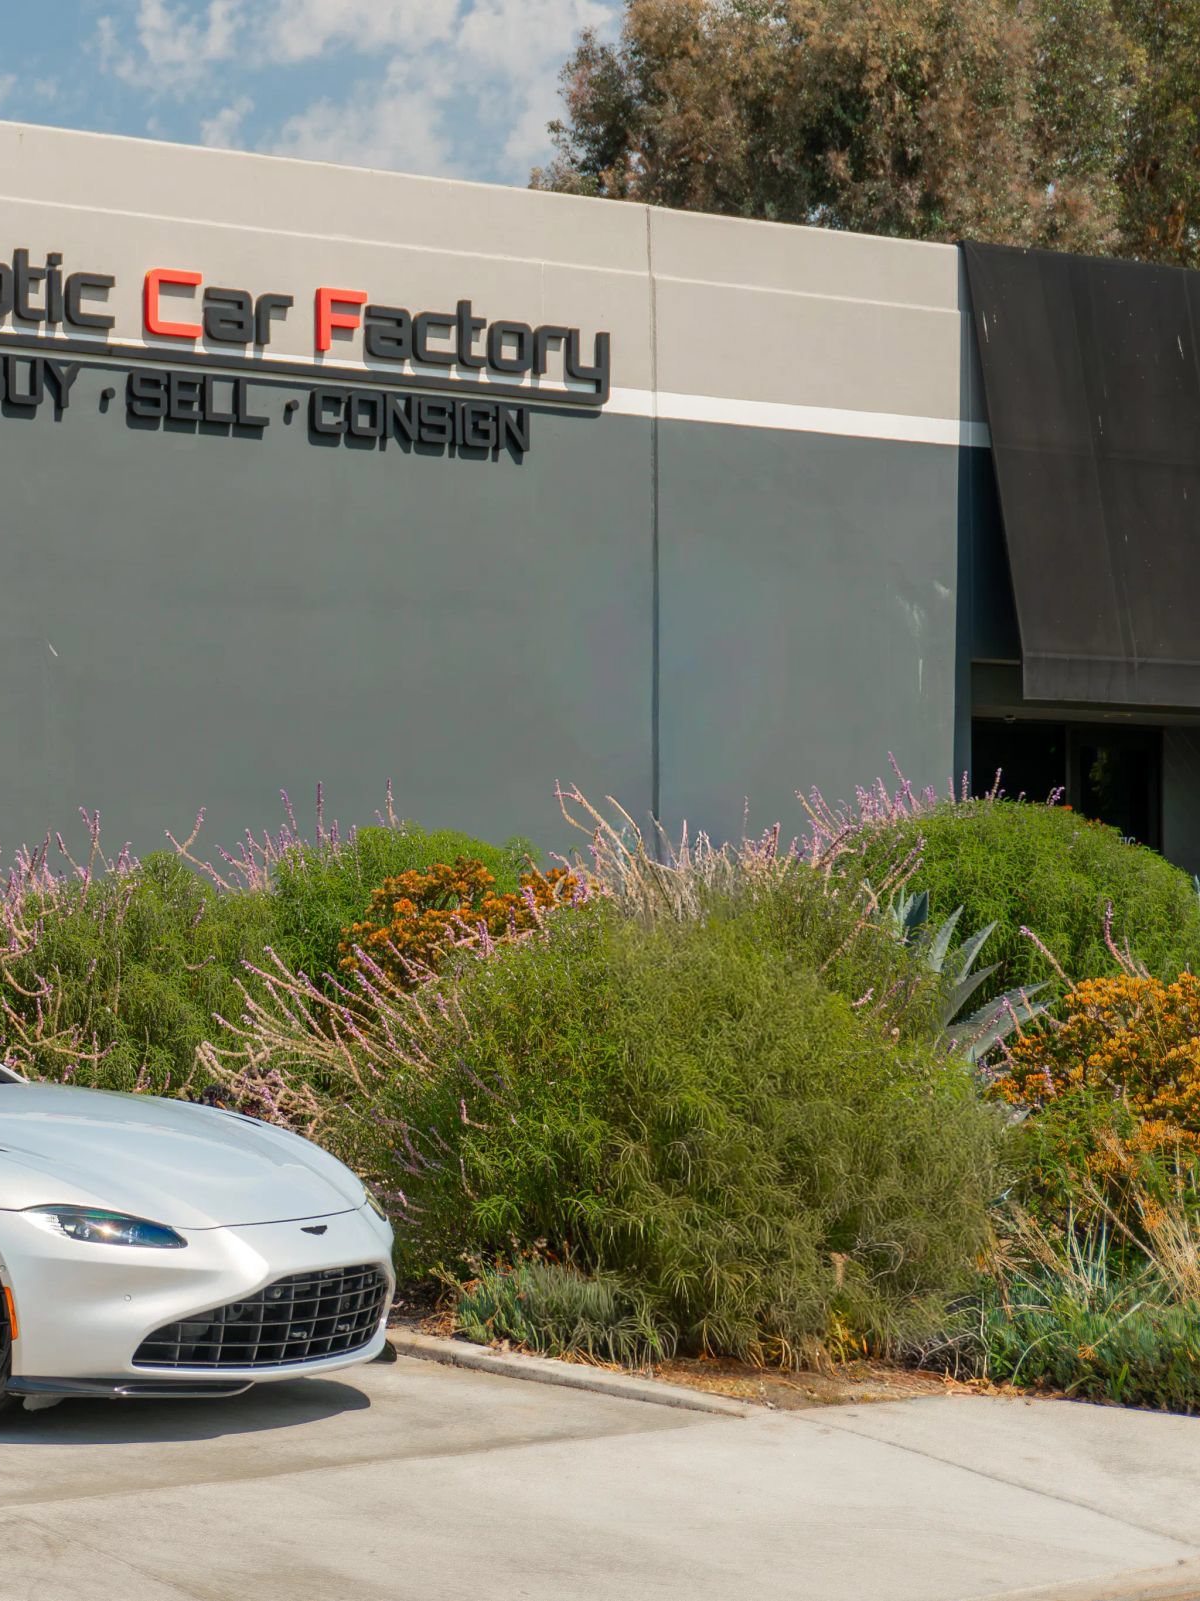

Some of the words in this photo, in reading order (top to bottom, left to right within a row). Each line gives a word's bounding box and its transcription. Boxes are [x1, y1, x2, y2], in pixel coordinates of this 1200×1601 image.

[145, 268, 294, 345] Car
[316, 287, 610, 403] Factory
[128, 370, 269, 427] SELL
[311, 387, 530, 452] CONSIGN
